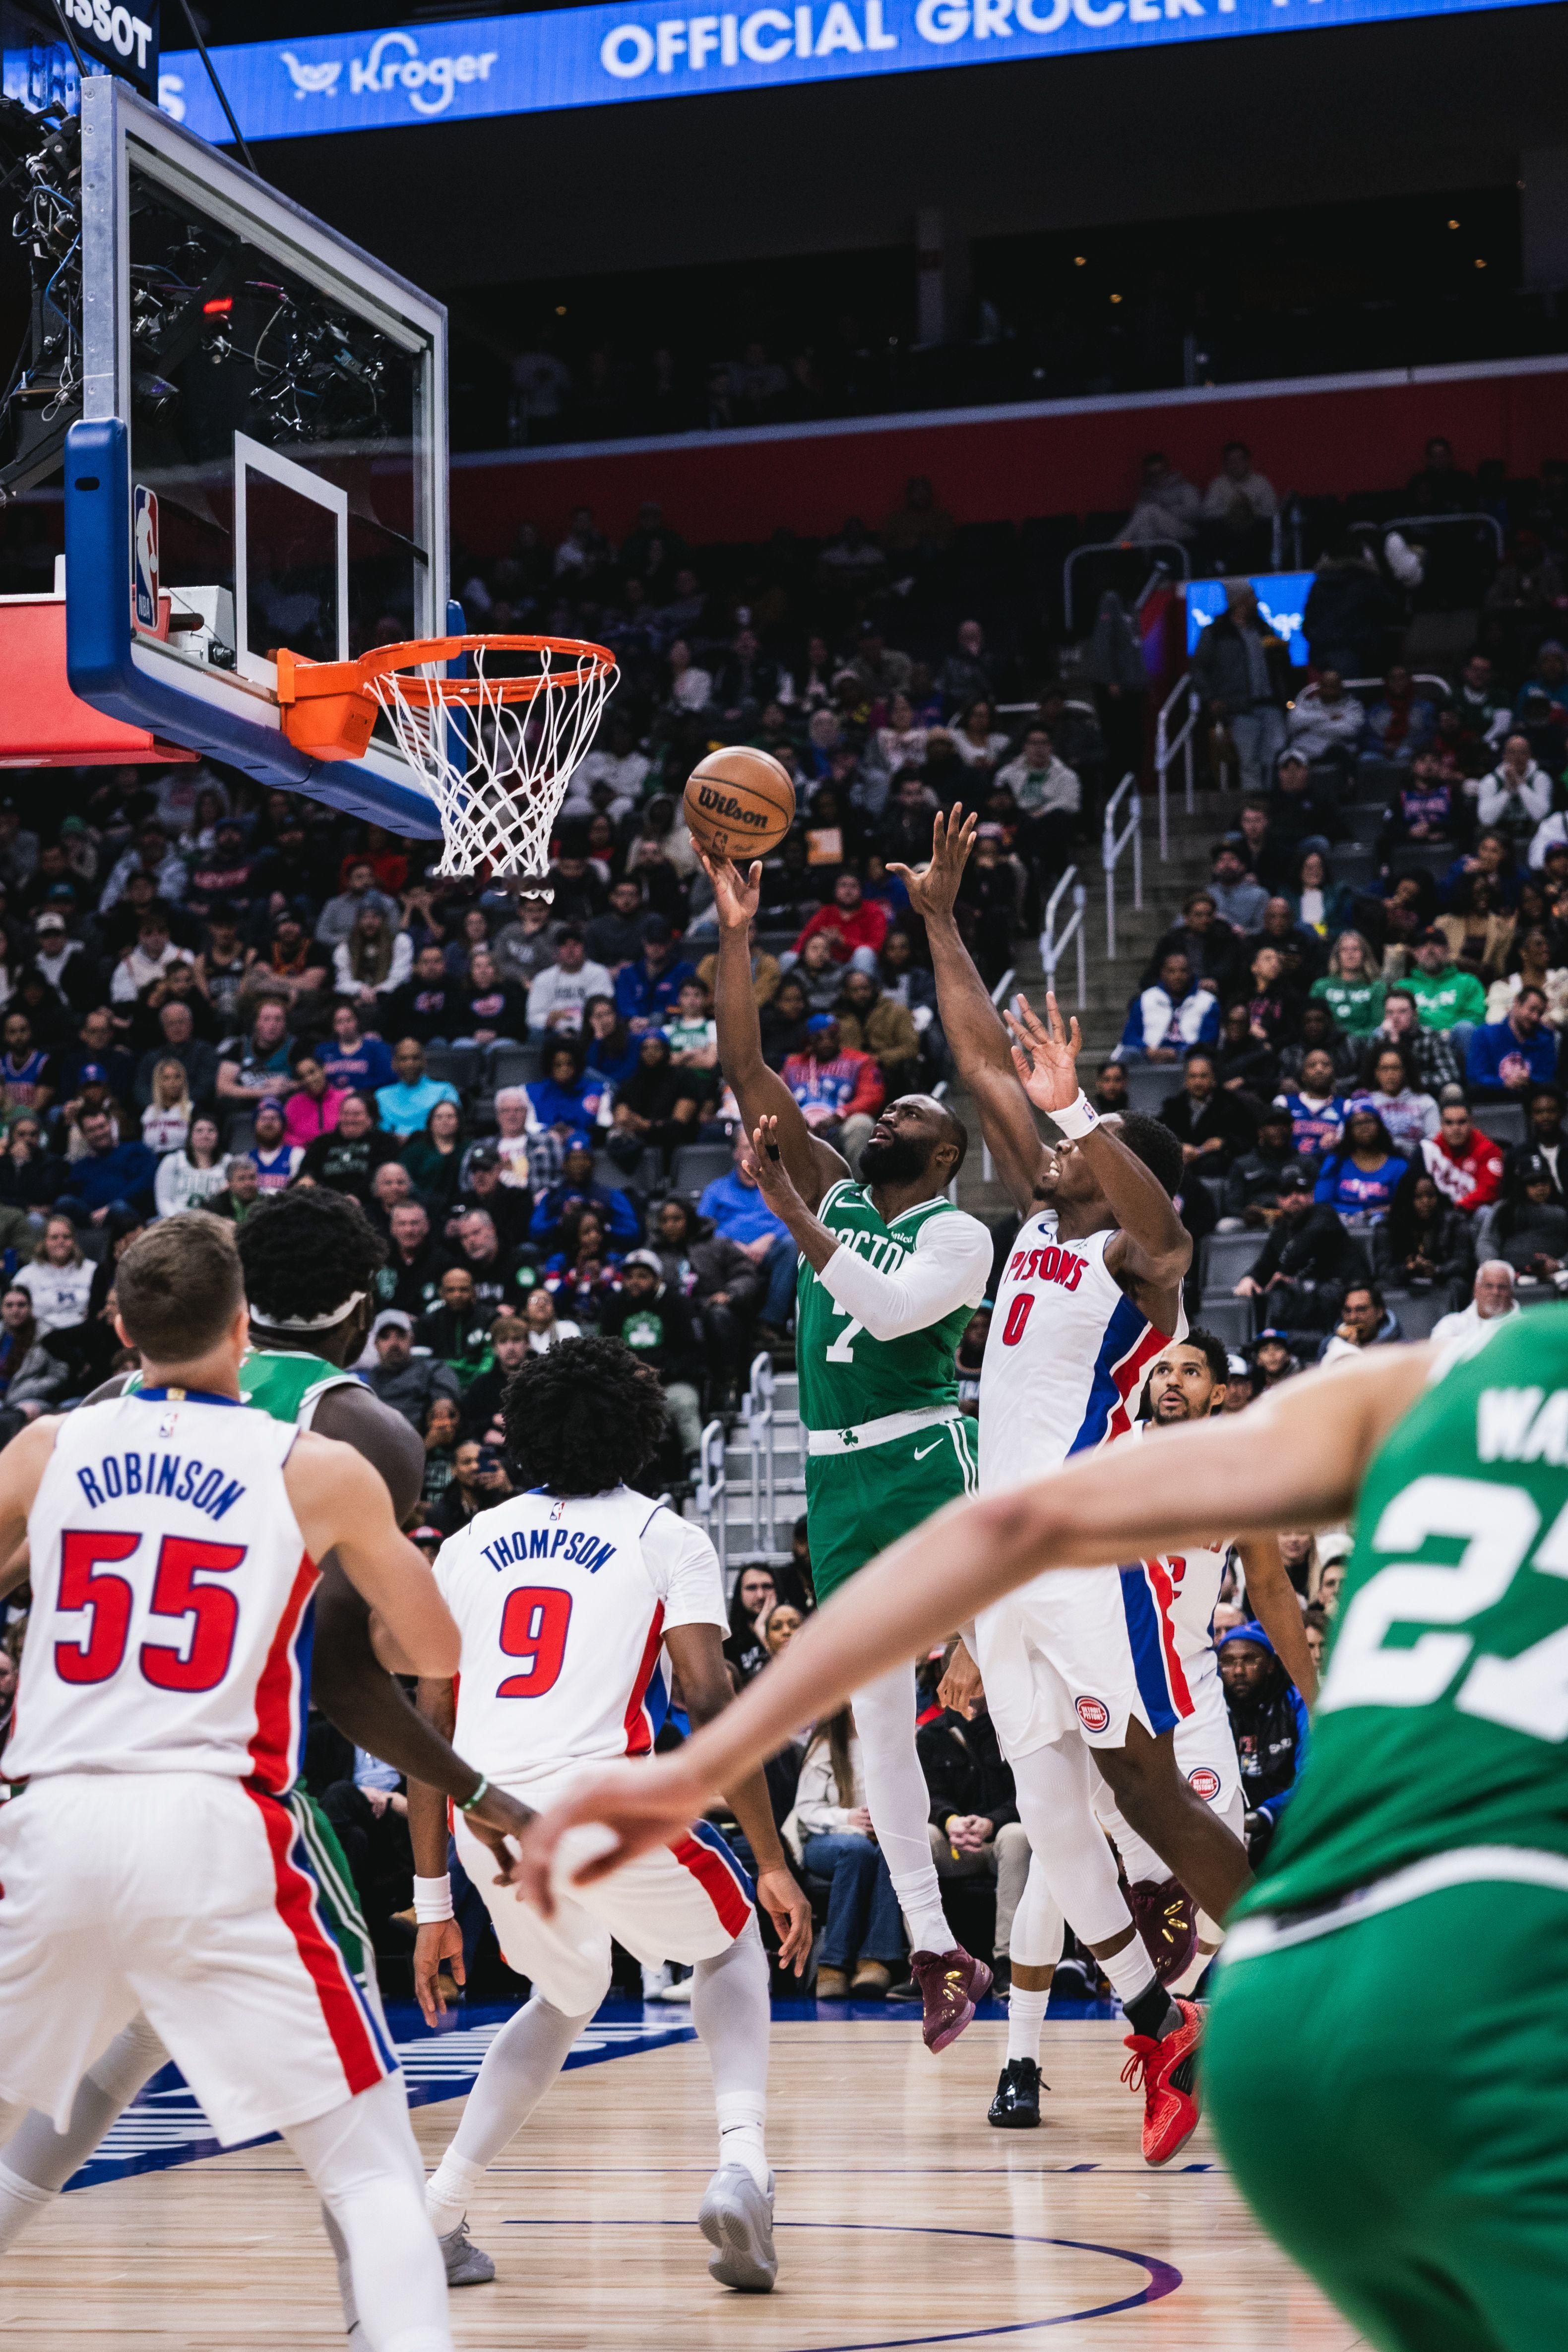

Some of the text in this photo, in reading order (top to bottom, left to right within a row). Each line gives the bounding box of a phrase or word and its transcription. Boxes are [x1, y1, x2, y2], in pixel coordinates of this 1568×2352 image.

[57, 0, 152, 69] SSOT
[601, 0, 897, 78] OFFICIAL
[350, 32, 498, 114] Kroger
[698, 785, 768, 828] Wilson
[891, 1231, 913, 1243] mica
[1004, 1246, 1090, 1292] PISONS
[1003, 1293, 1035, 1346] 0
[1477, 1387, 1568, 1468] WA
[76, 1452, 247, 1521] ROBINSON
[480, 1529, 617, 1574] THOMPSON
[54, 1529, 248, 1693] 55
[496, 1585, 572, 1698] 9
